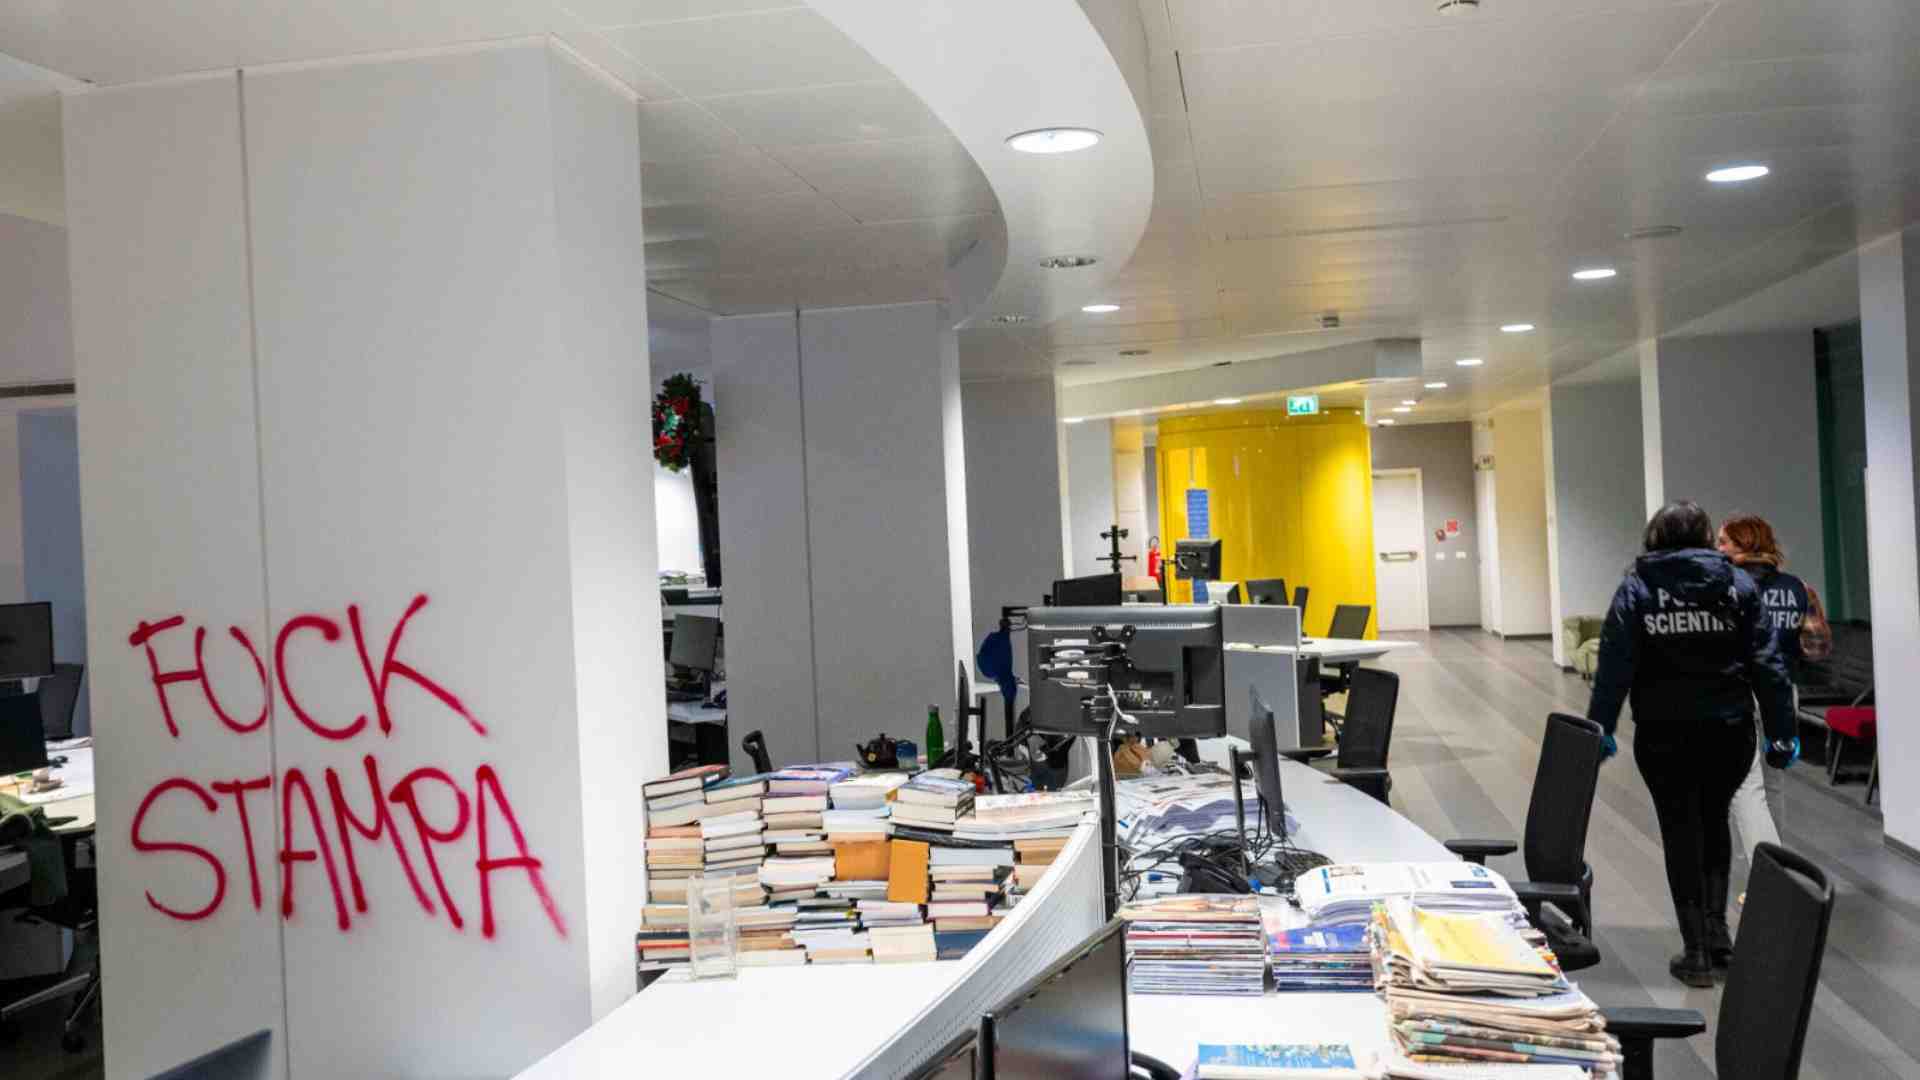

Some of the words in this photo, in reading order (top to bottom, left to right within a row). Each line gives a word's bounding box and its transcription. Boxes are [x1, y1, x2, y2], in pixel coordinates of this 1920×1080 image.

[128, 593, 488, 742] FUCK
[1762, 588, 1798, 607] IZIA
[131, 753, 569, 941] STAMPA
